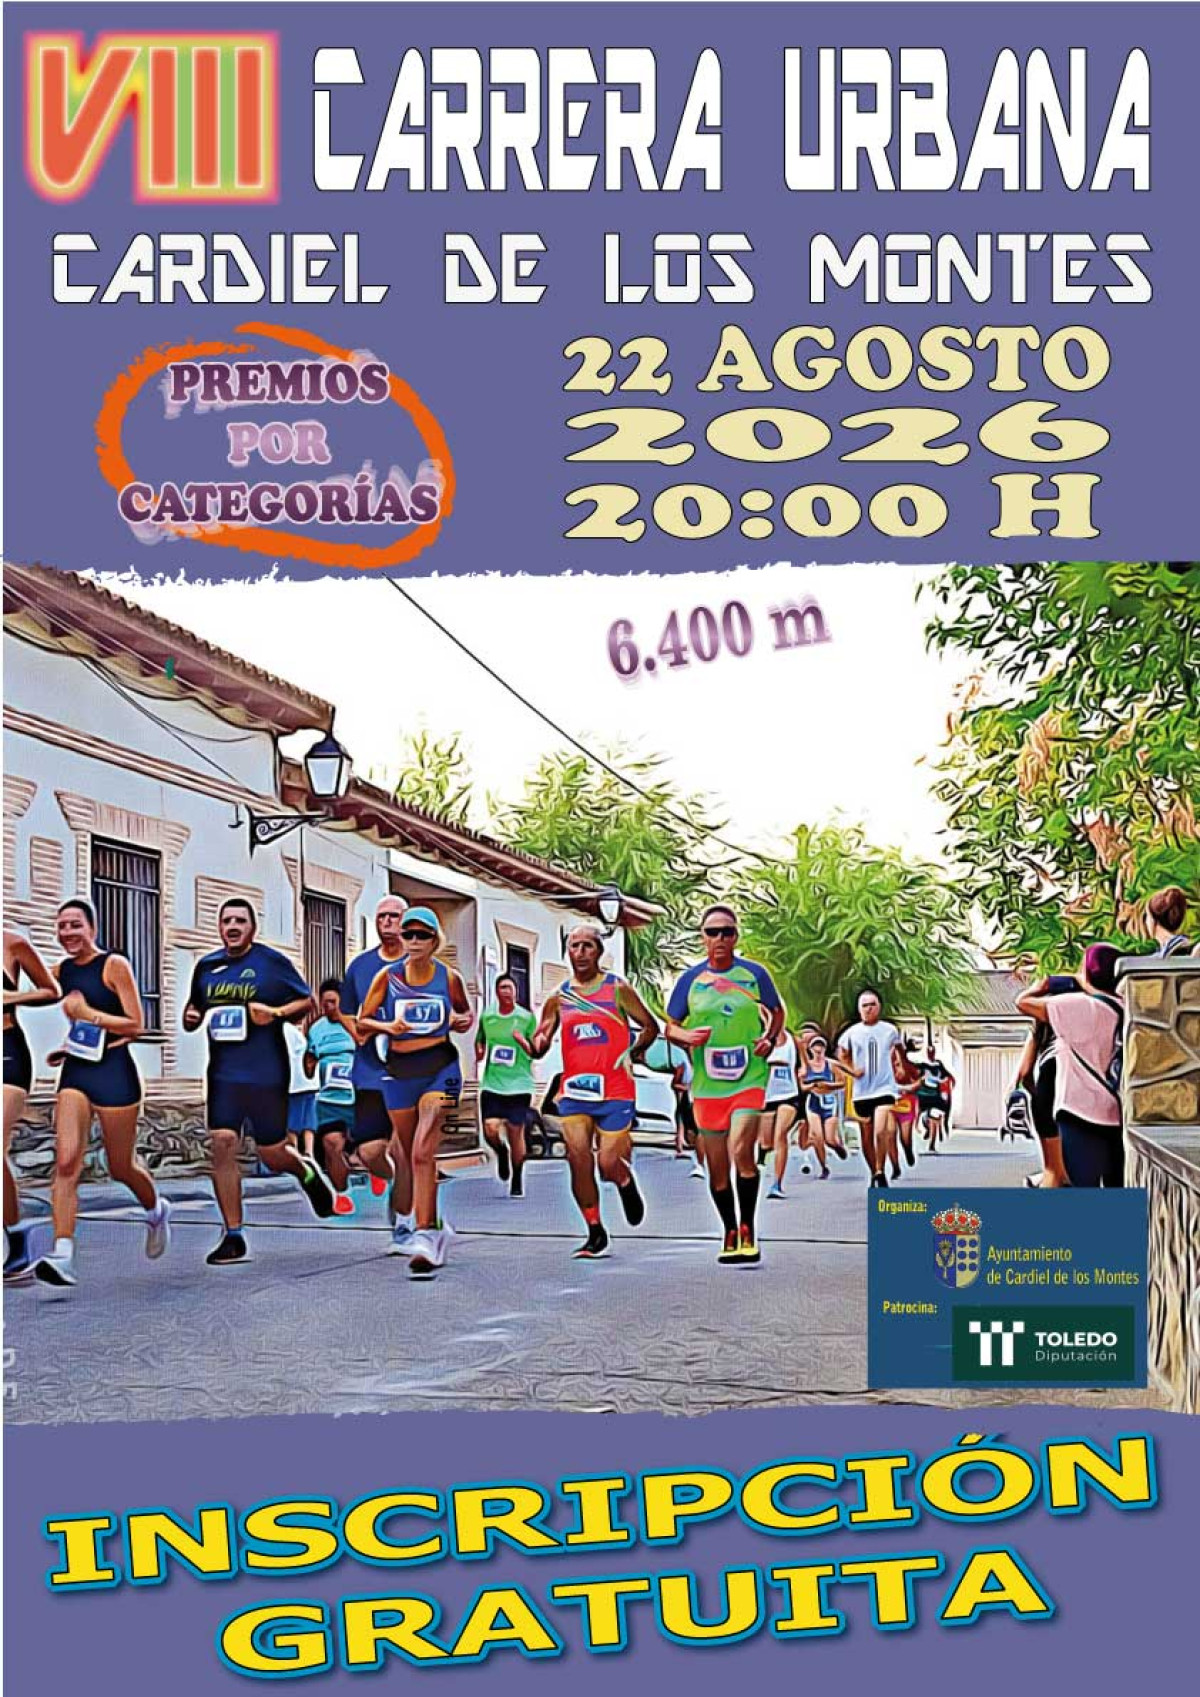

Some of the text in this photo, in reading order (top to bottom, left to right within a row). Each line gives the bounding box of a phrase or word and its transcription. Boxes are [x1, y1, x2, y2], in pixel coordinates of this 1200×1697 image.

[32, 38, 1151, 198] VIII CARRERA URBANA
[52, 232, 1154, 304] CARDIEL DE LOS MONTES
[166, 361, 390, 405] PREMIOS
[562, 324, 1112, 396] 22 AGOSTO
[226, 420, 332, 466] POR
[563, 398, 1112, 467] 2026
[118, 472, 441, 525] CATEGORÍAS
[563, 472, 1103, 544] 20:00 H
[607, 599, 832, 677] 6.400 m
[877, 1199, 928, 1214] Organiza:
[986, 1246, 1073, 1265] Ayuntamiento
[986, 1269, 1140, 1285] de Cardiel de los Montes
[882, 1300, 938, 1314] Patrocina:
[1034, 1331, 1118, 1347] TOLEDO
[1035, 1349, 1118, 1364] Diputación
[46, 1433, 1155, 1589] INSCRIPCIÓN
[218, 1548, 1052, 1676] GRATUITA
